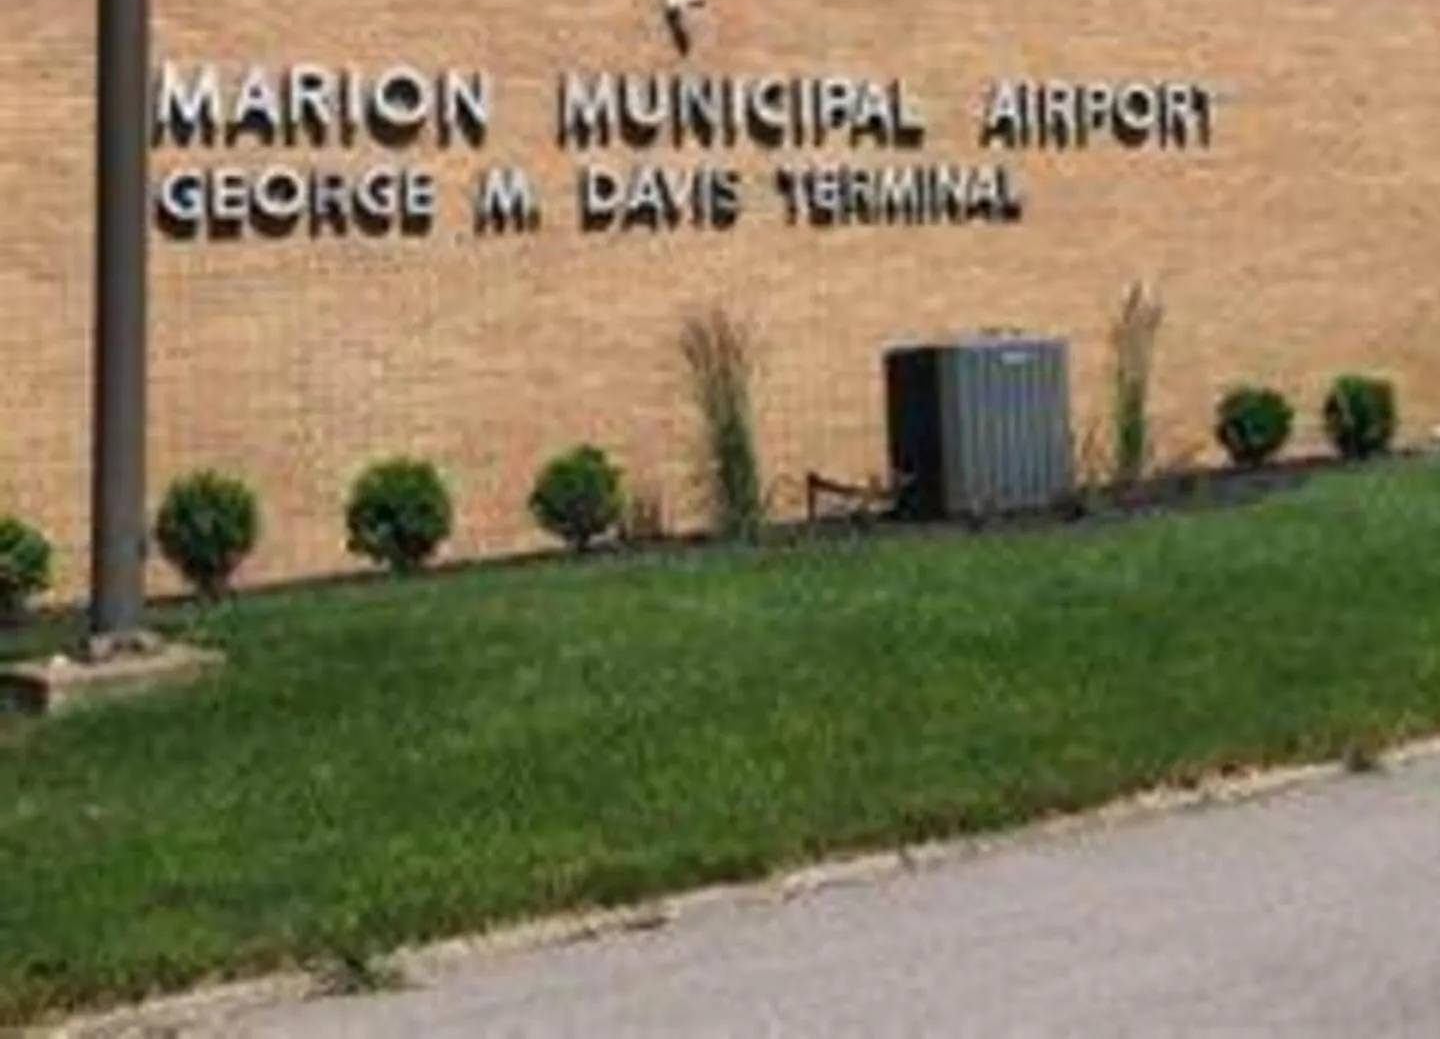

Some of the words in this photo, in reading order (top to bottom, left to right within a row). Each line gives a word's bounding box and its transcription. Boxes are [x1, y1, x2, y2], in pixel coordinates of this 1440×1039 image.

[155, 60, 491, 142] MARION
[562, 70, 924, 144] MUNICIPAL
[982, 77, 1217, 144] AIRPORT
[160, 166, 436, 234] GEORGE
[582, 165, 740, 228] DAVIS
[778, 164, 1022, 224] TERMINAL
